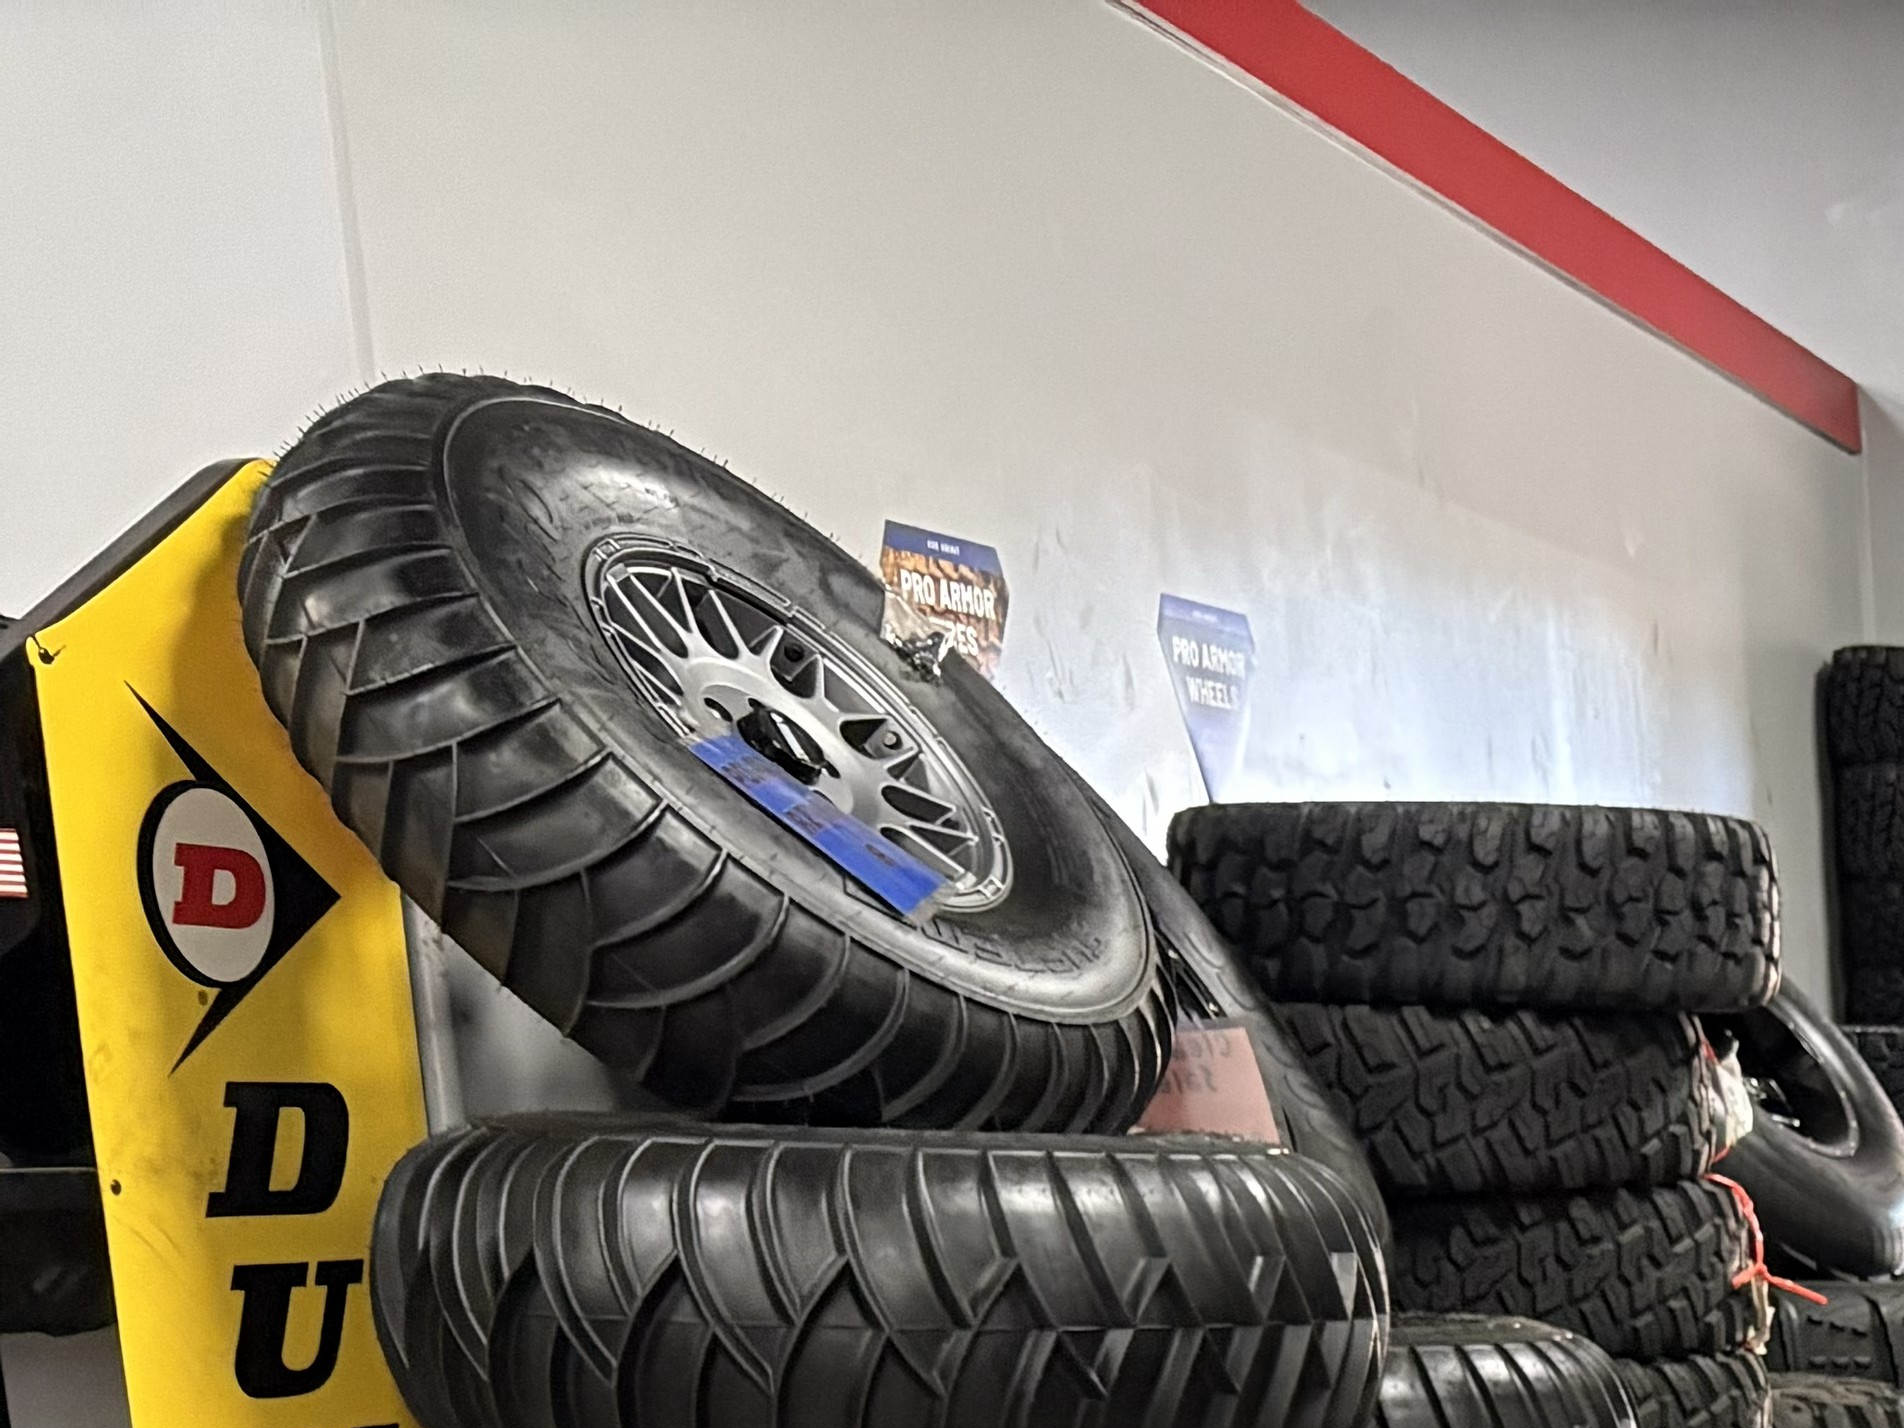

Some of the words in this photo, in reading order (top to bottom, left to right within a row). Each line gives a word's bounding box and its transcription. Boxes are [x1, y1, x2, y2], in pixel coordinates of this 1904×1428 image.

[900, 568, 936, 607] PRO
[939, 578, 996, 621] ARMOR
[1172, 635, 1200, 668] PRO
[1202, 643, 1245, 680] ARMOR
[1185, 675, 1240, 711] WHEELS
[172, 842, 268, 929] D
